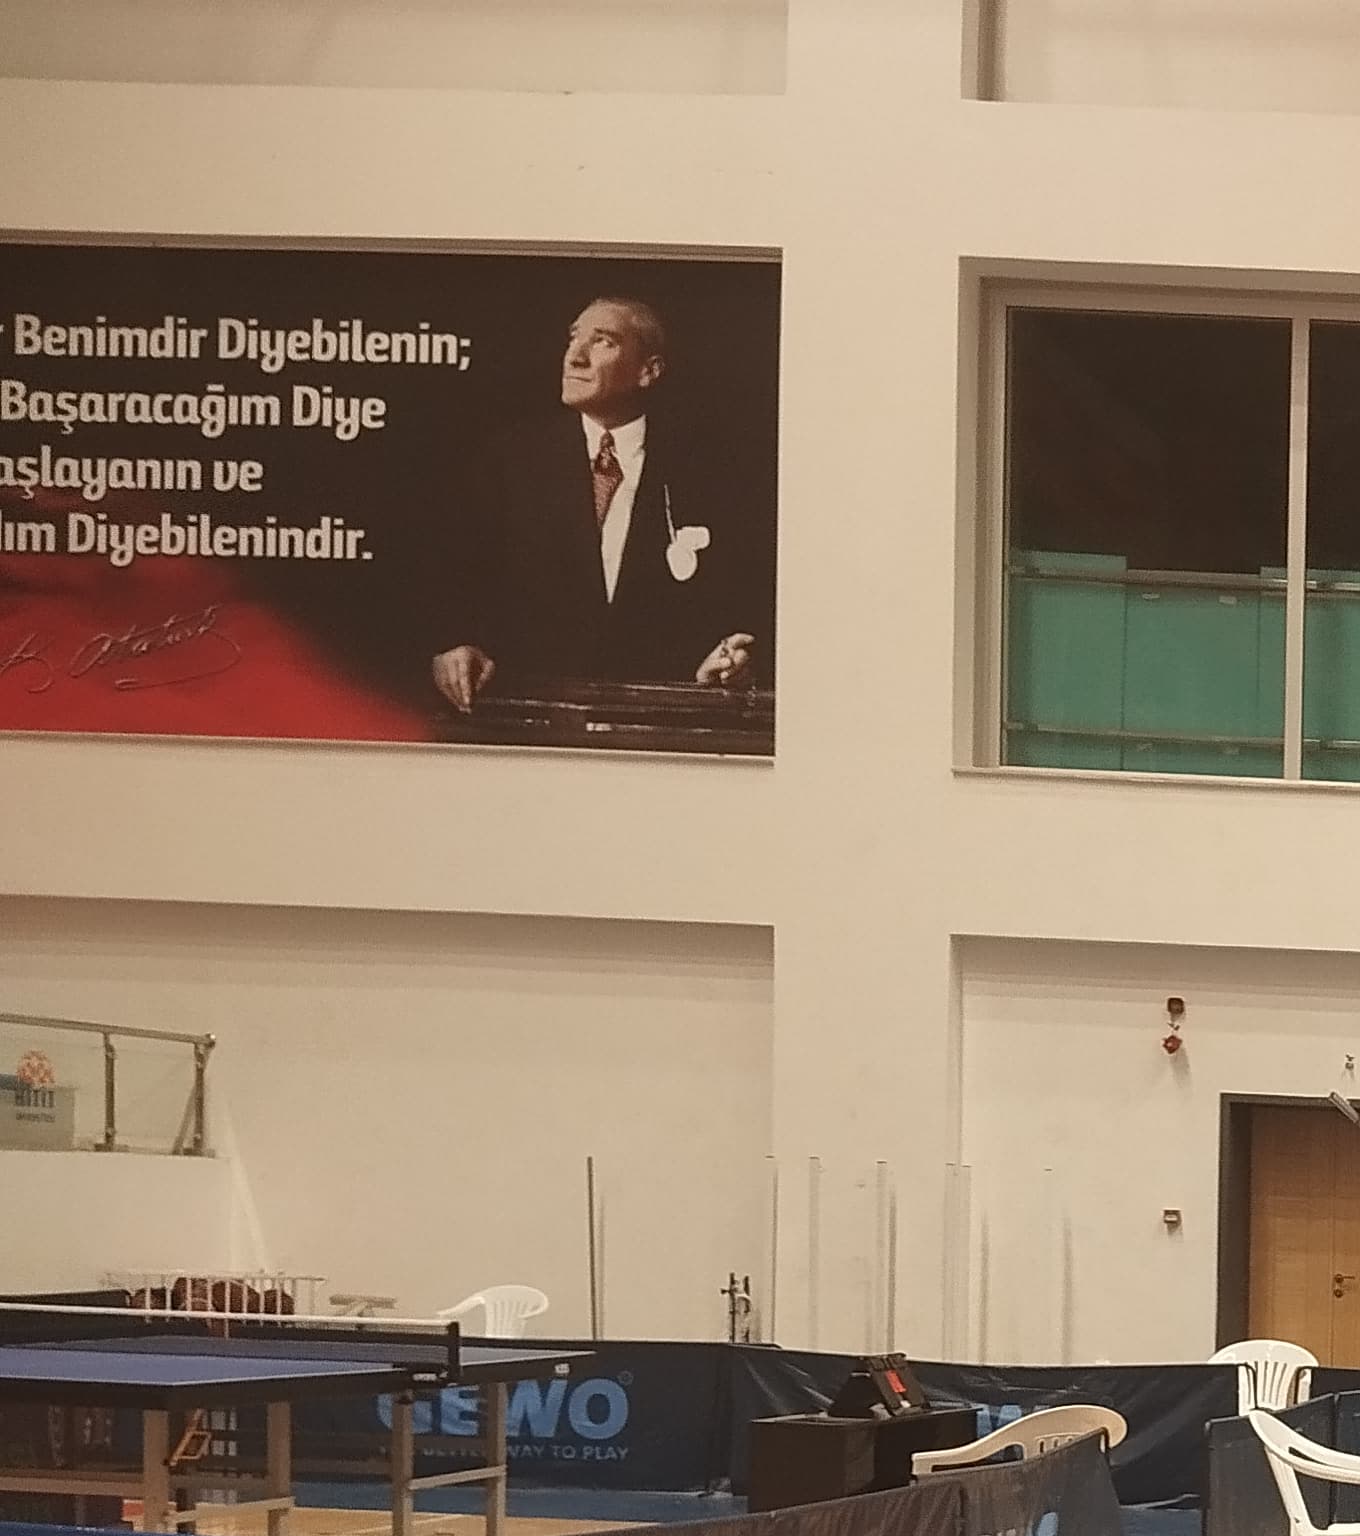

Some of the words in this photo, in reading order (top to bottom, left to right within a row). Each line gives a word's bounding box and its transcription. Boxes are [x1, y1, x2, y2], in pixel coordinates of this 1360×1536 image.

[14, 313, 207, 359] Benimdir
[217, 318, 470, 373] Diyebilenin;
[0, 379, 280, 436] Başaracağım
[293, 383, 386, 440] Diye
[213, 462, 263, 493] ve
[67, 512, 373, 567] Diyebilenindir.
[583, 1447, 628, 1460] PLAY
